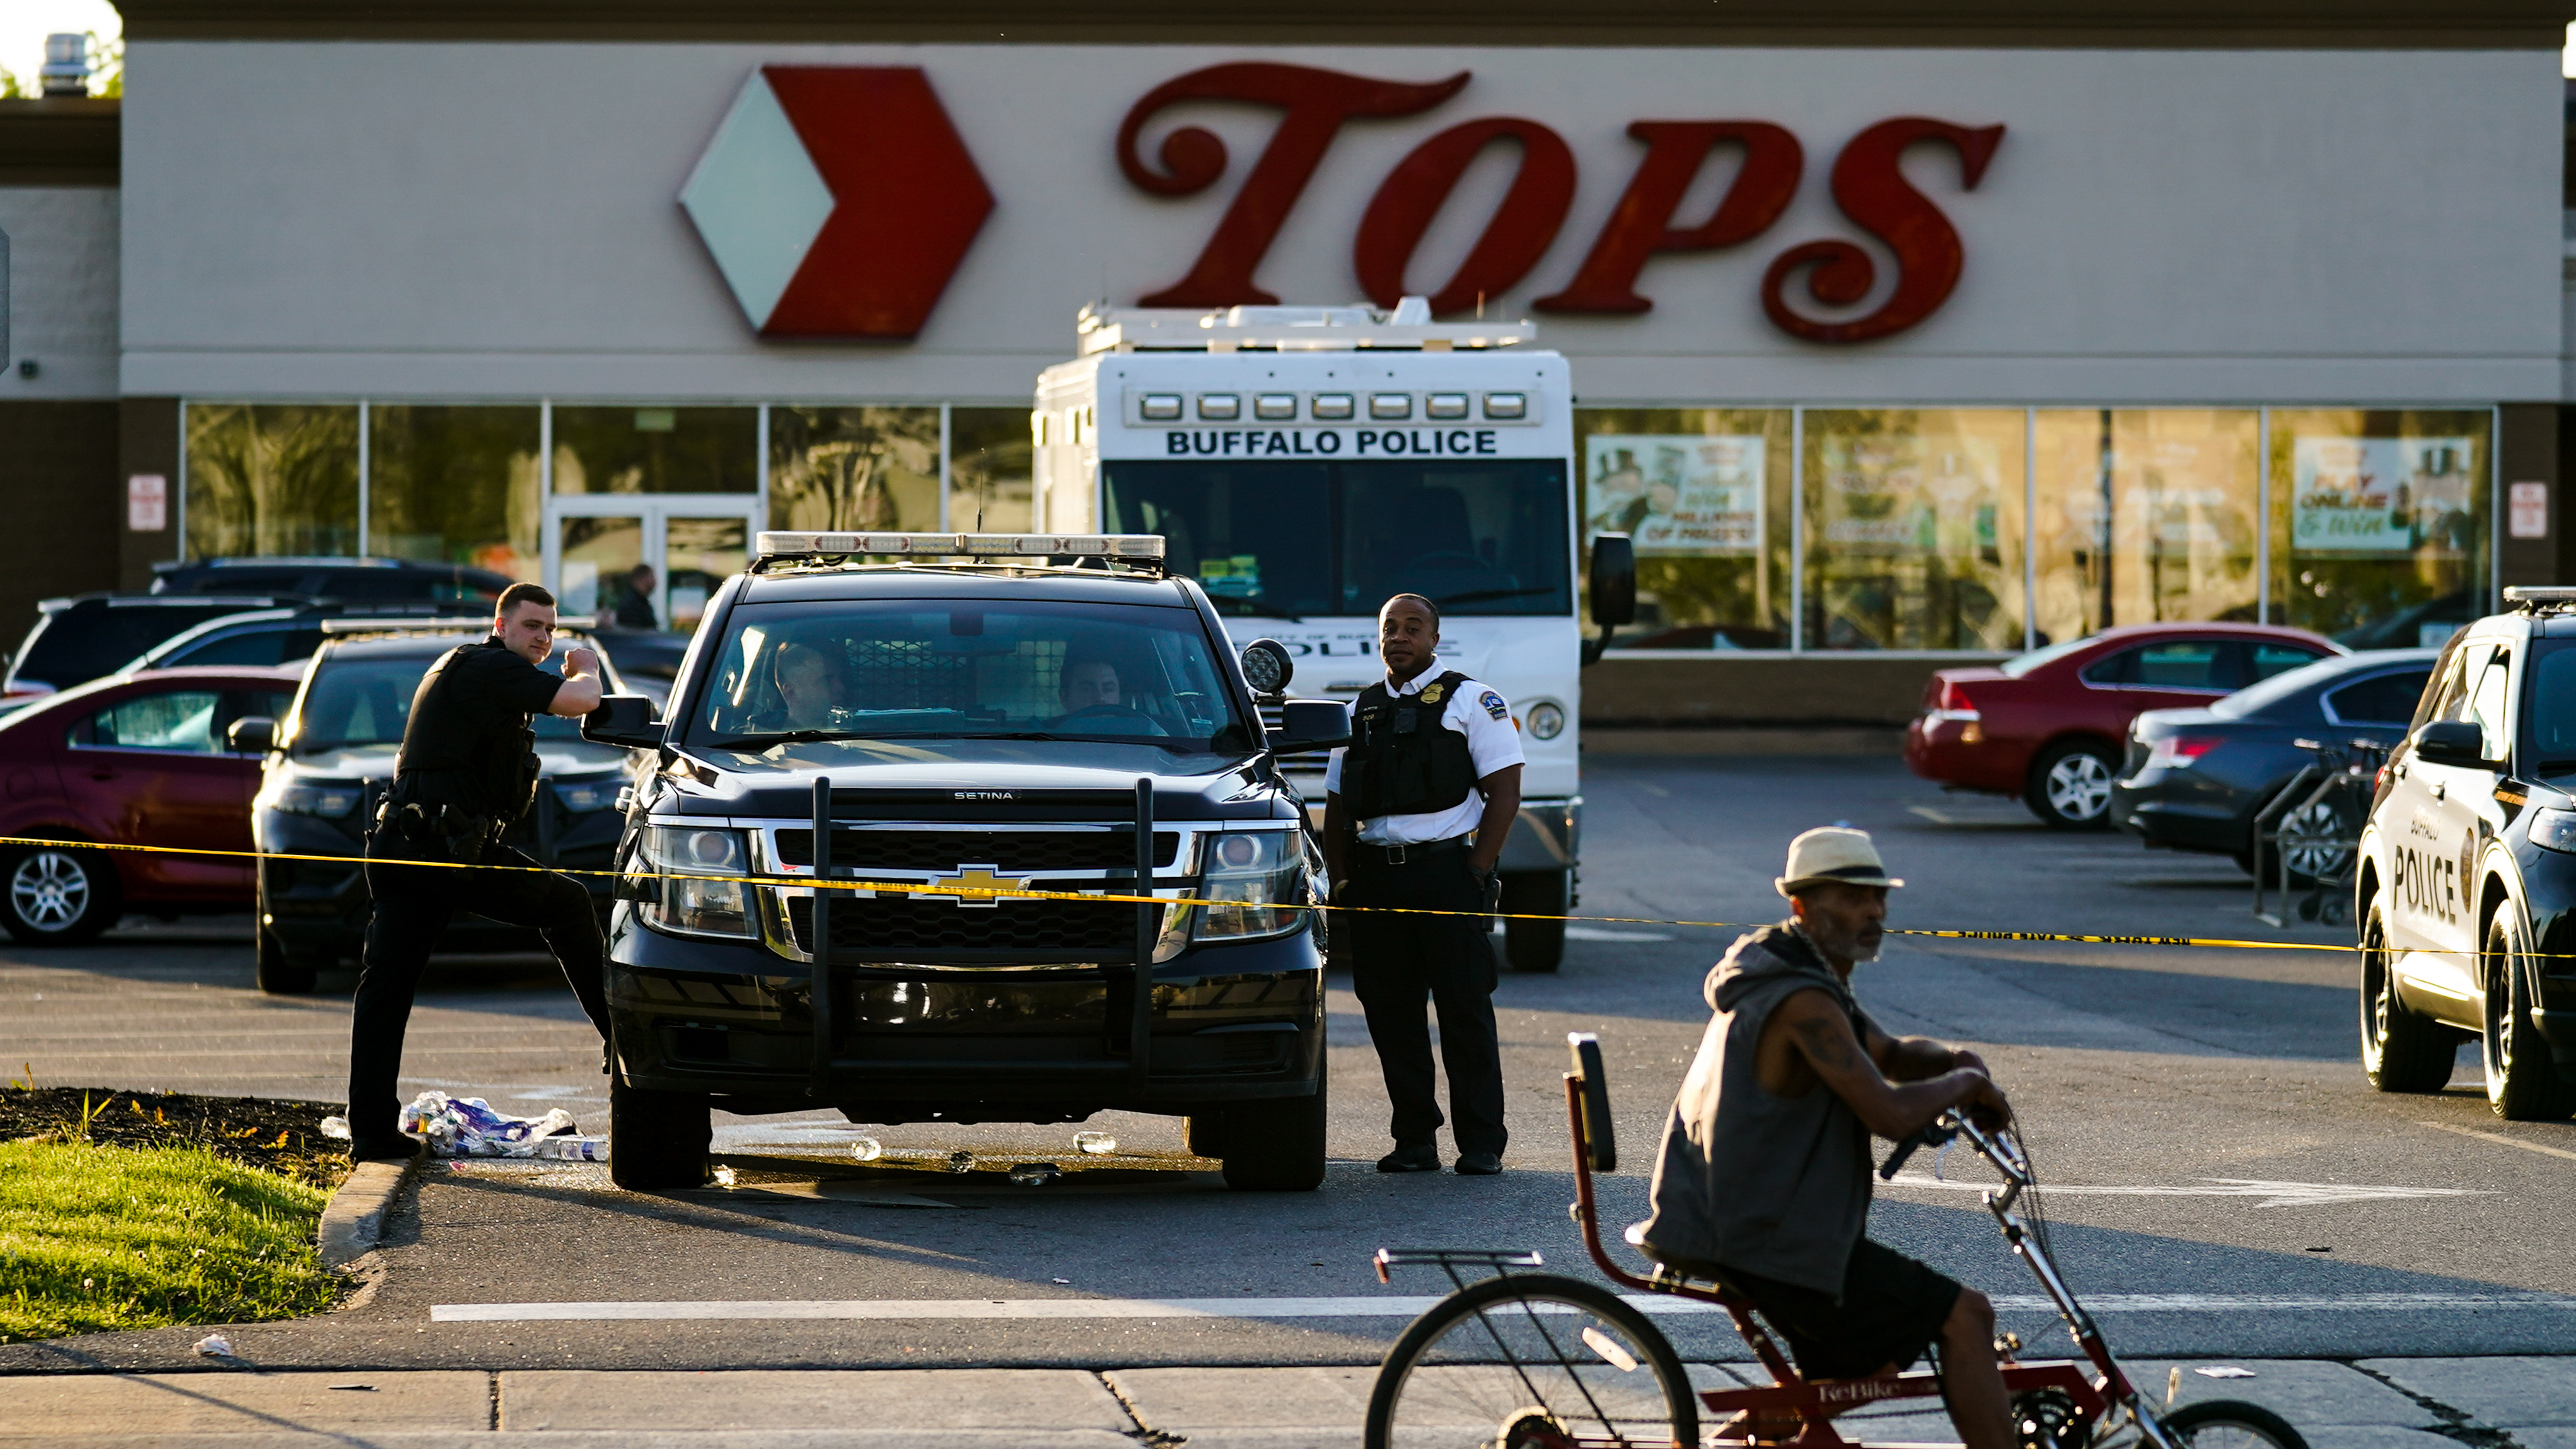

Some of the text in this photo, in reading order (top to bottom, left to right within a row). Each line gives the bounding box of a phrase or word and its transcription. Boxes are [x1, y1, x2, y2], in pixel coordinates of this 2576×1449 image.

[1166, 430, 1497, 455] BUFFALO POLICE
[2411, 813, 2440, 841] BUFFALO
[2393, 844, 2456, 926] POLICE
[1819, 1380, 1900, 1404] ReBike
